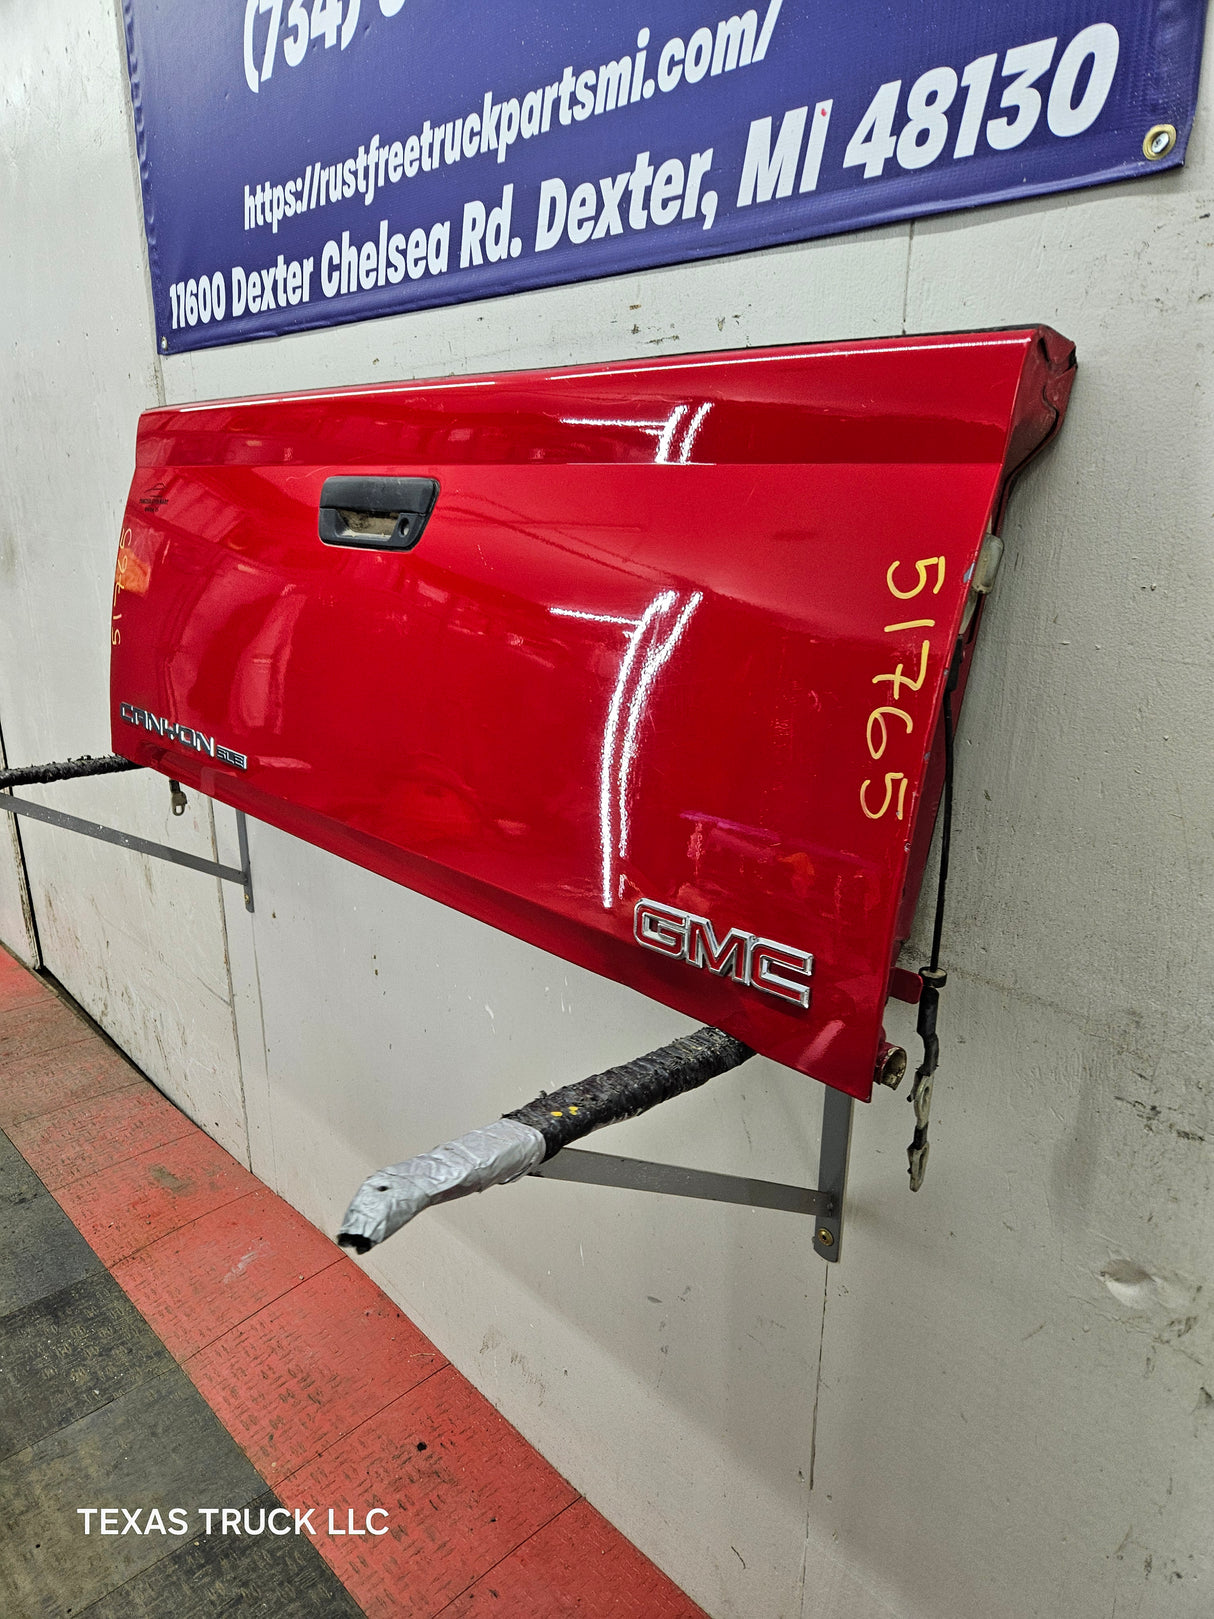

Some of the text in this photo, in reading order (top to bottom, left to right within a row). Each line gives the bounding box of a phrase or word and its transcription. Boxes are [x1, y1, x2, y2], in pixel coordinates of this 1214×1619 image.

[169, 22, 1120, 329] 11600 Dexter Chelsea Rd. Dexter, MI 48130
[243, 0, 784, 234] https://rustfreetruckpartsmi.com/
[119, 702, 248, 770] CANYON SLE
[859, 555, 946, 820] 51765
[633, 897, 815, 1009] GMC
